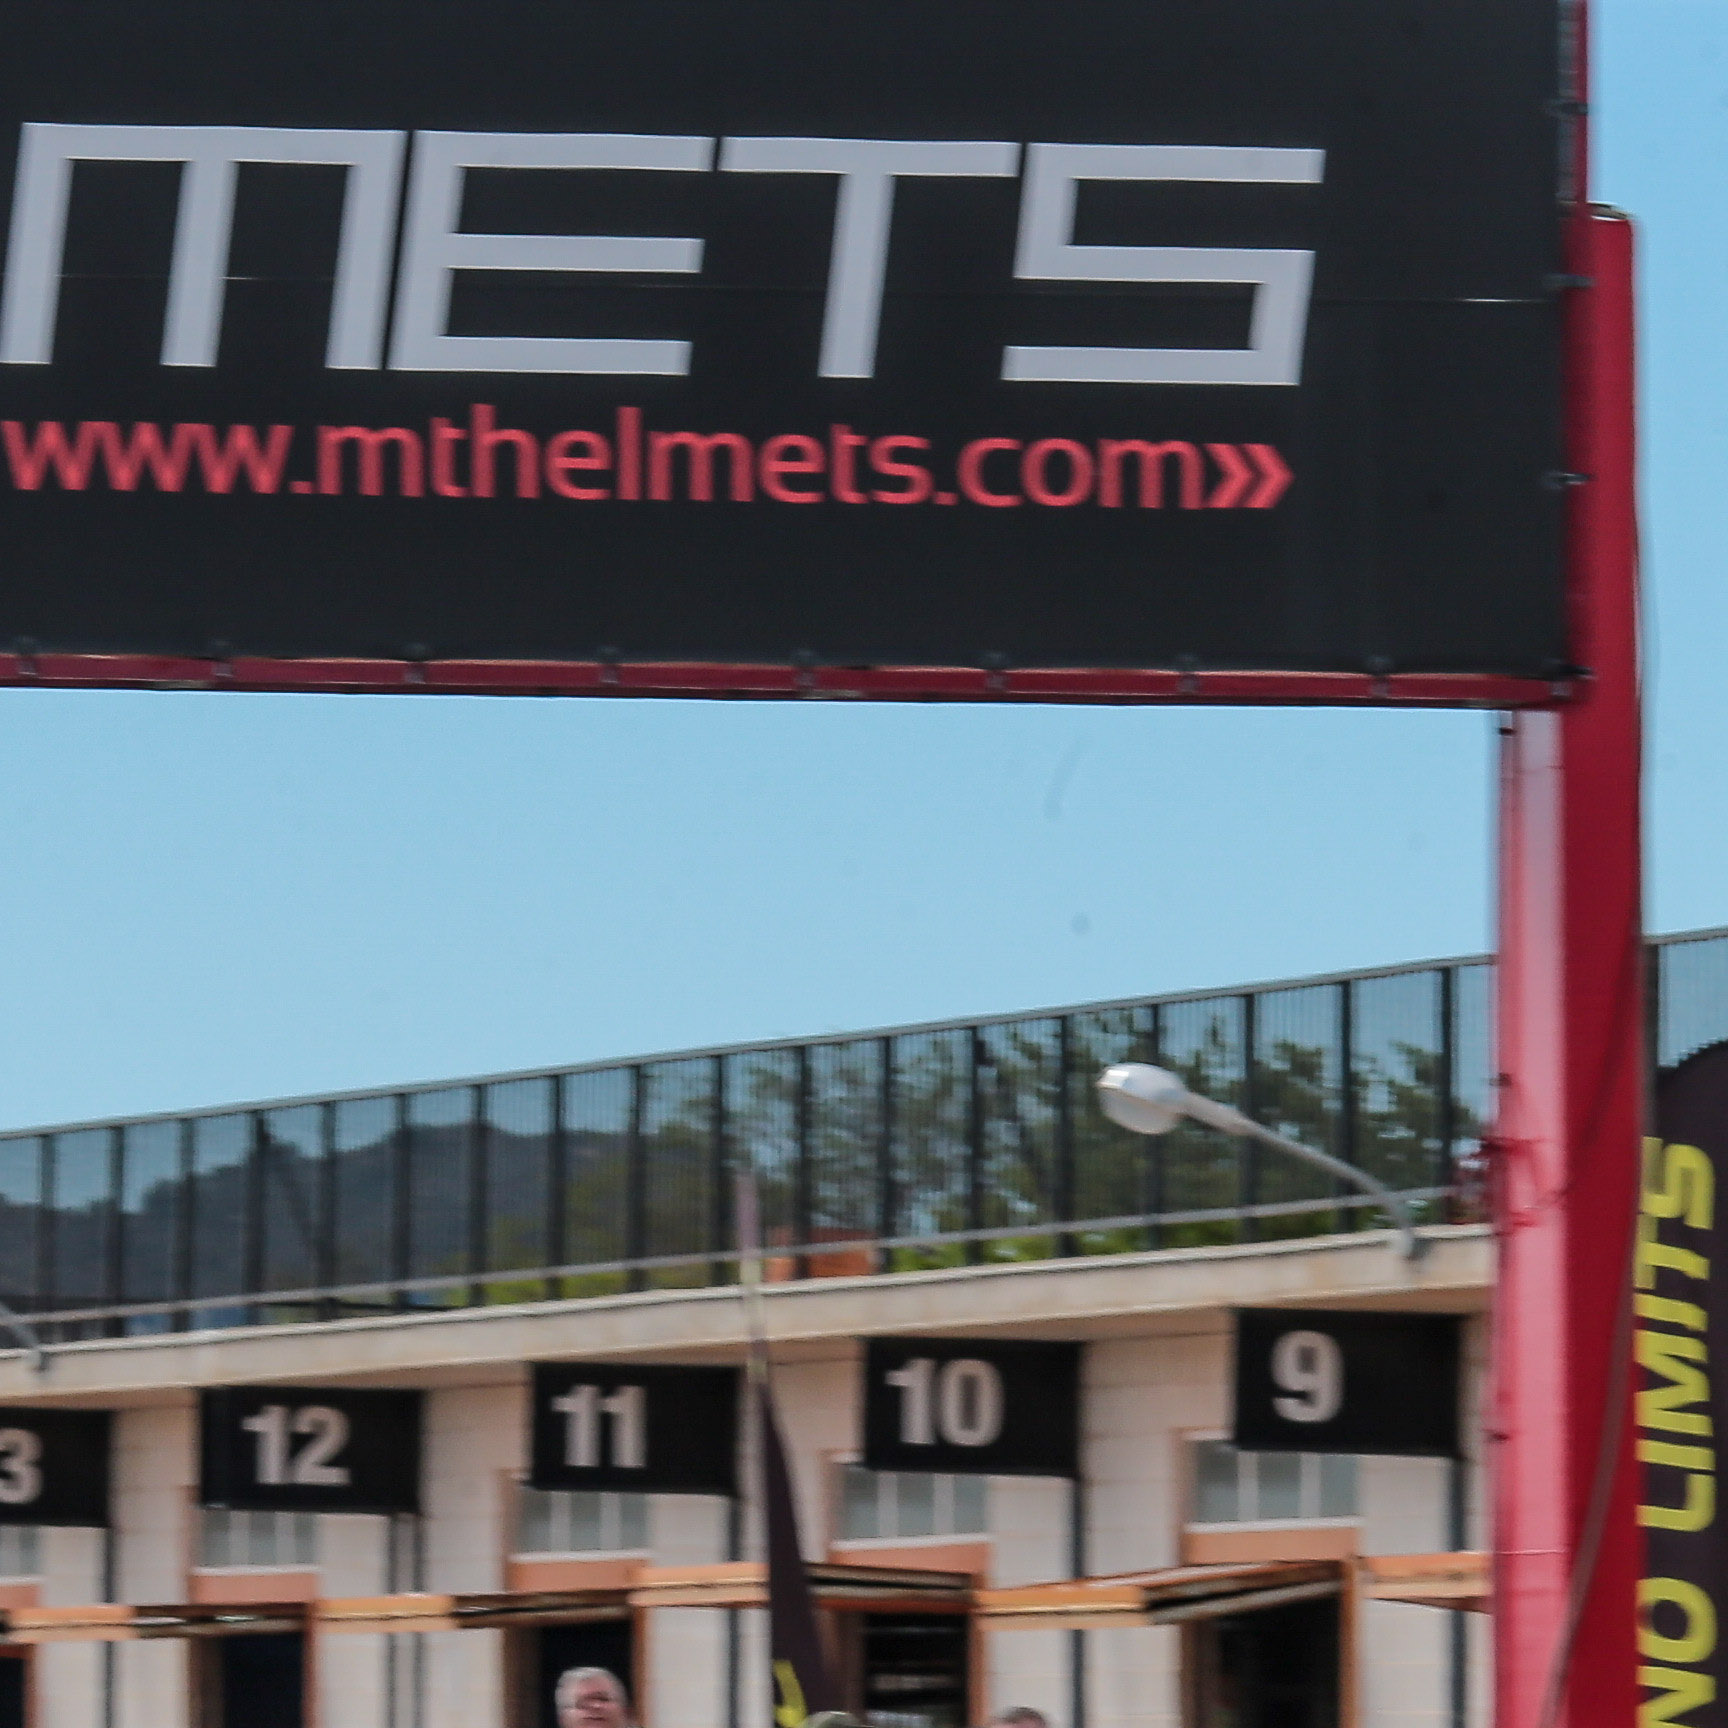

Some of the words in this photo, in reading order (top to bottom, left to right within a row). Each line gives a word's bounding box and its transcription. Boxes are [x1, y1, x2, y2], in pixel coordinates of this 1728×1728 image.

[1271, 1330, 1343, 1423] 9
[1633, 1136, 1716, 1532] LIMITS
[243, 1405, 351, 1485] 12
[552, 1385, 647, 1468] 11
[886, 1358, 1004, 1446] 10
